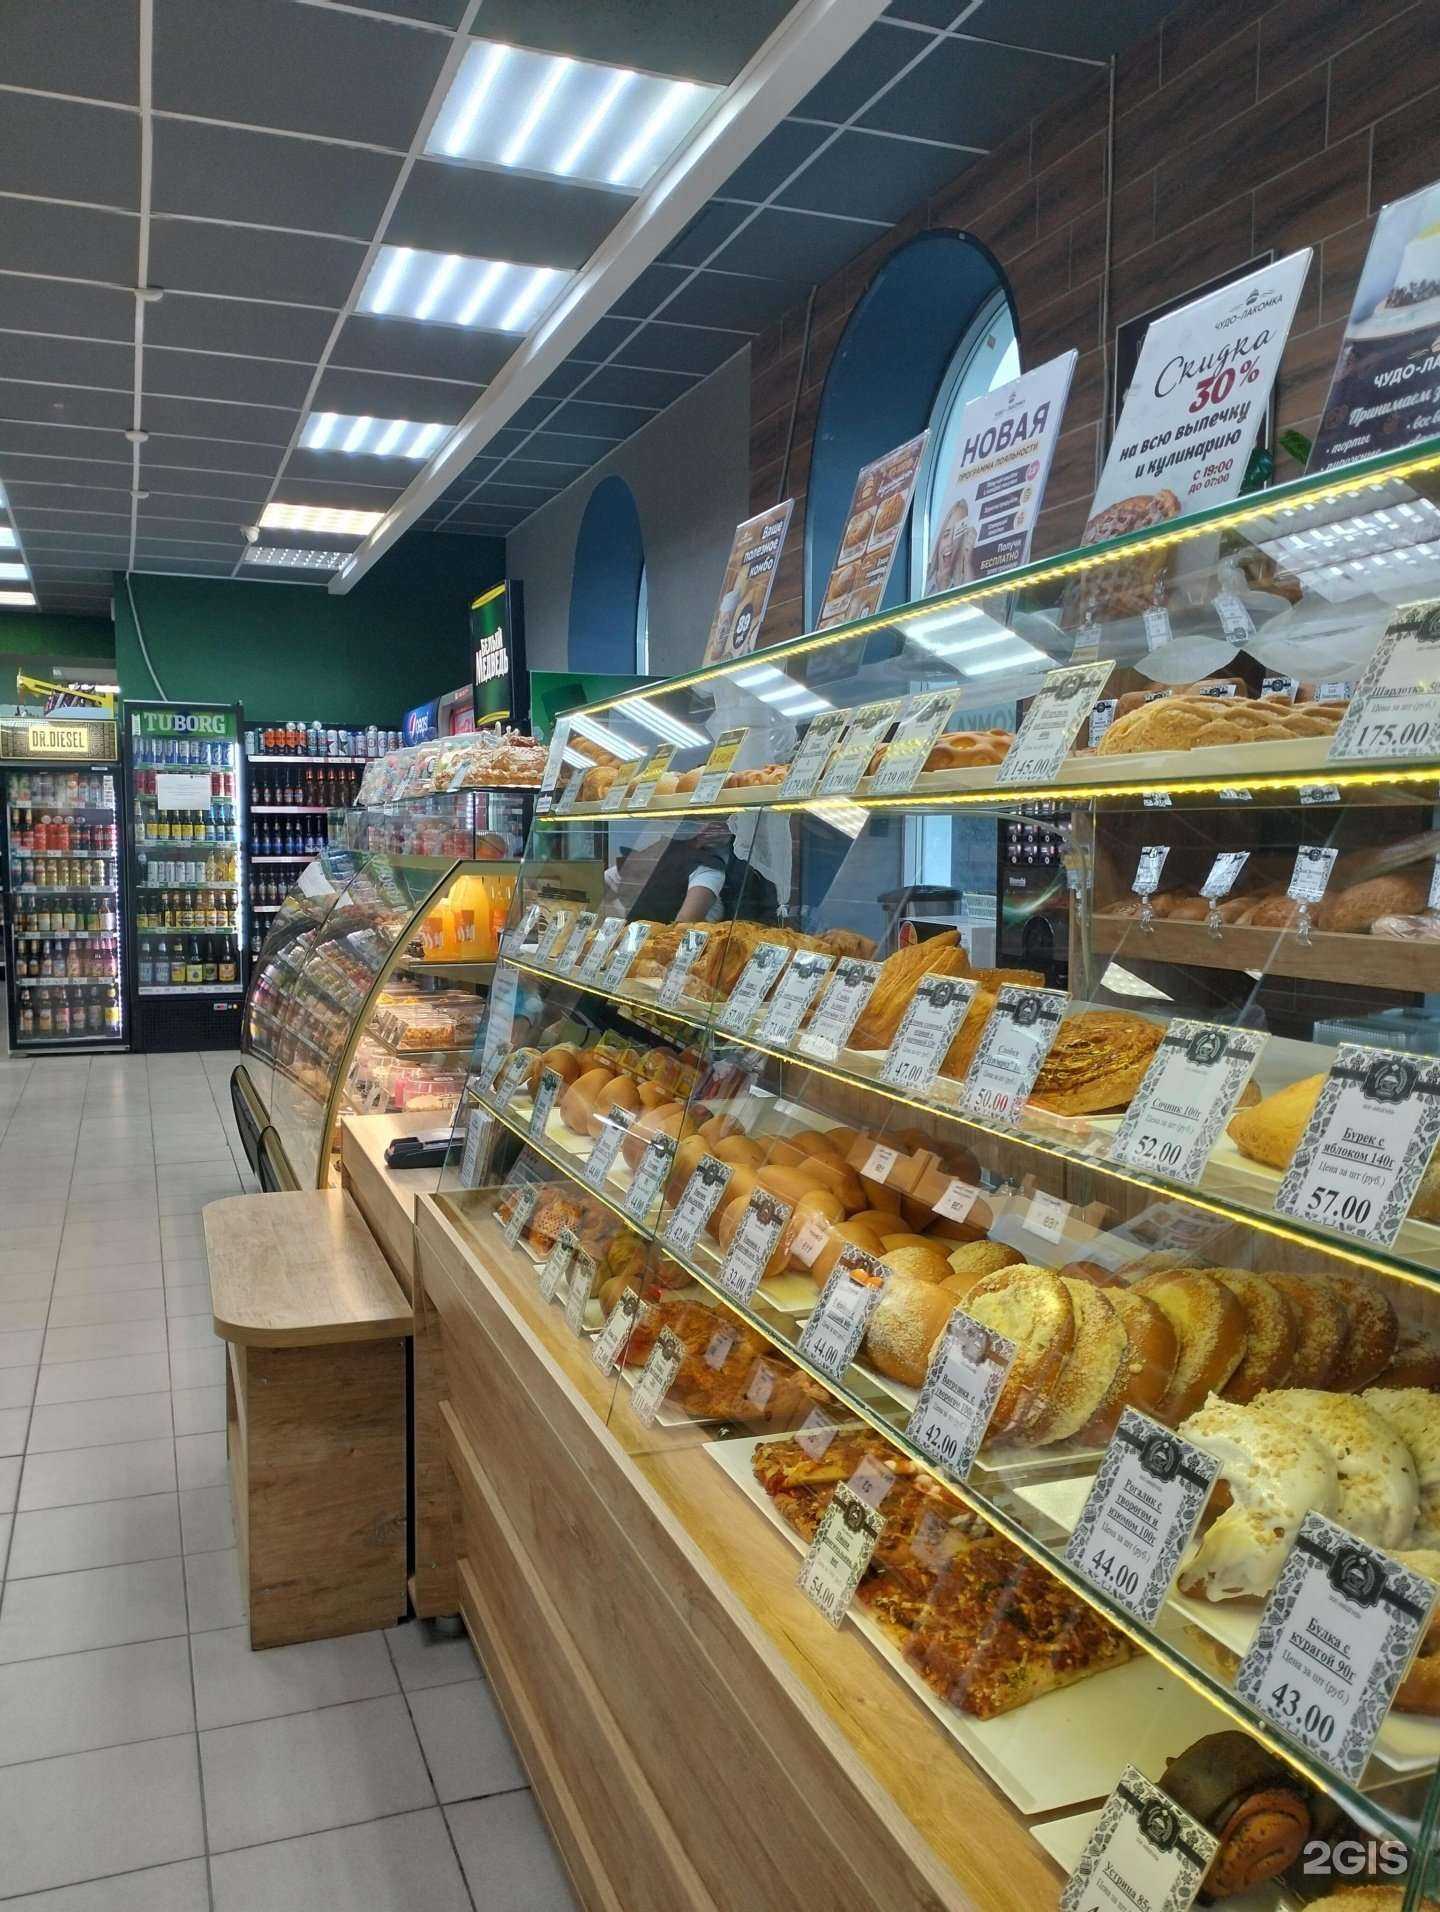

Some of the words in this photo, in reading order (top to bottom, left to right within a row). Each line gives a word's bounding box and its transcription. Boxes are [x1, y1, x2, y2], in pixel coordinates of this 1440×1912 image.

[1154, 329, 1275, 398] Скидка
[1188, 356, 1260, 413] 30%
[960, 400, 1051, 468] НОВАЯ
[1119, 442, 1139, 462] на
[1140, 430, 1172, 454] всю
[1174, 400, 1252, 442] выпечку
[1135, 463, 1146, 479] и
[1147, 428, 1243, 478] кулинарию
[1203, 458, 1235, 478] 19:00
[1188, 482, 1202, 496] до
[761, 520, 784, 540] Ваше
[743, 538, 779, 564] полезное
[749, 556, 774, 577] комбо
[480, 626, 503, 654] БЕЛЫЙ
[32, 730, 85, 748] DR.DIESEL
[143, 711, 226, 734] TUBORG
[1357, 721, 1431, 747] 175.00
[976, 1088, 1009, 1113] 50.00
[1135, 1135, 1182, 1165] 52.00
[1343, 1127, 1377, 1145] Бурек
[1378, 1138, 1385, 1147] с
[1318, 1160, 1338, 1175] Цена
[1339, 1168, 1347, 1177] за
[1349, 1171, 1361, 1181] шт
[1322, 1142, 1369, 1162] яблоком
[1370, 1152, 1396, 1169] 140г
[1307, 1185, 1371, 1225] 57.00
[814, 1337, 839, 1366] 44.00
[925, 1423, 959, 1458] 42.00
[1116, 1494, 1153, 1523] творогом
[1152, 1518, 1159, 1527] и
[1124, 1478, 1157, 1508] Рогалик
[1157, 1501, 1163, 1511] с
[1108, 1506, 1138, 1532] изюмом
[1139, 1525, 1156, 1544] 100г
[1092, 1548, 1140, 1596] 44.00
[810, 1576, 835, 1609] 54.00
[1307, 1617, 1342, 1649] Булка
[1343, 1644, 1351, 1655] с
[1282, 1649, 1303, 1671] Цена
[1302, 1665, 1312, 1678] за
[1312, 1672, 1325, 1687] шт
[1290, 1631, 1336, 1668] курагой
[1336, 1660, 1357, 1681] 90г
[1271, 1682, 1336, 1744] 43.00
